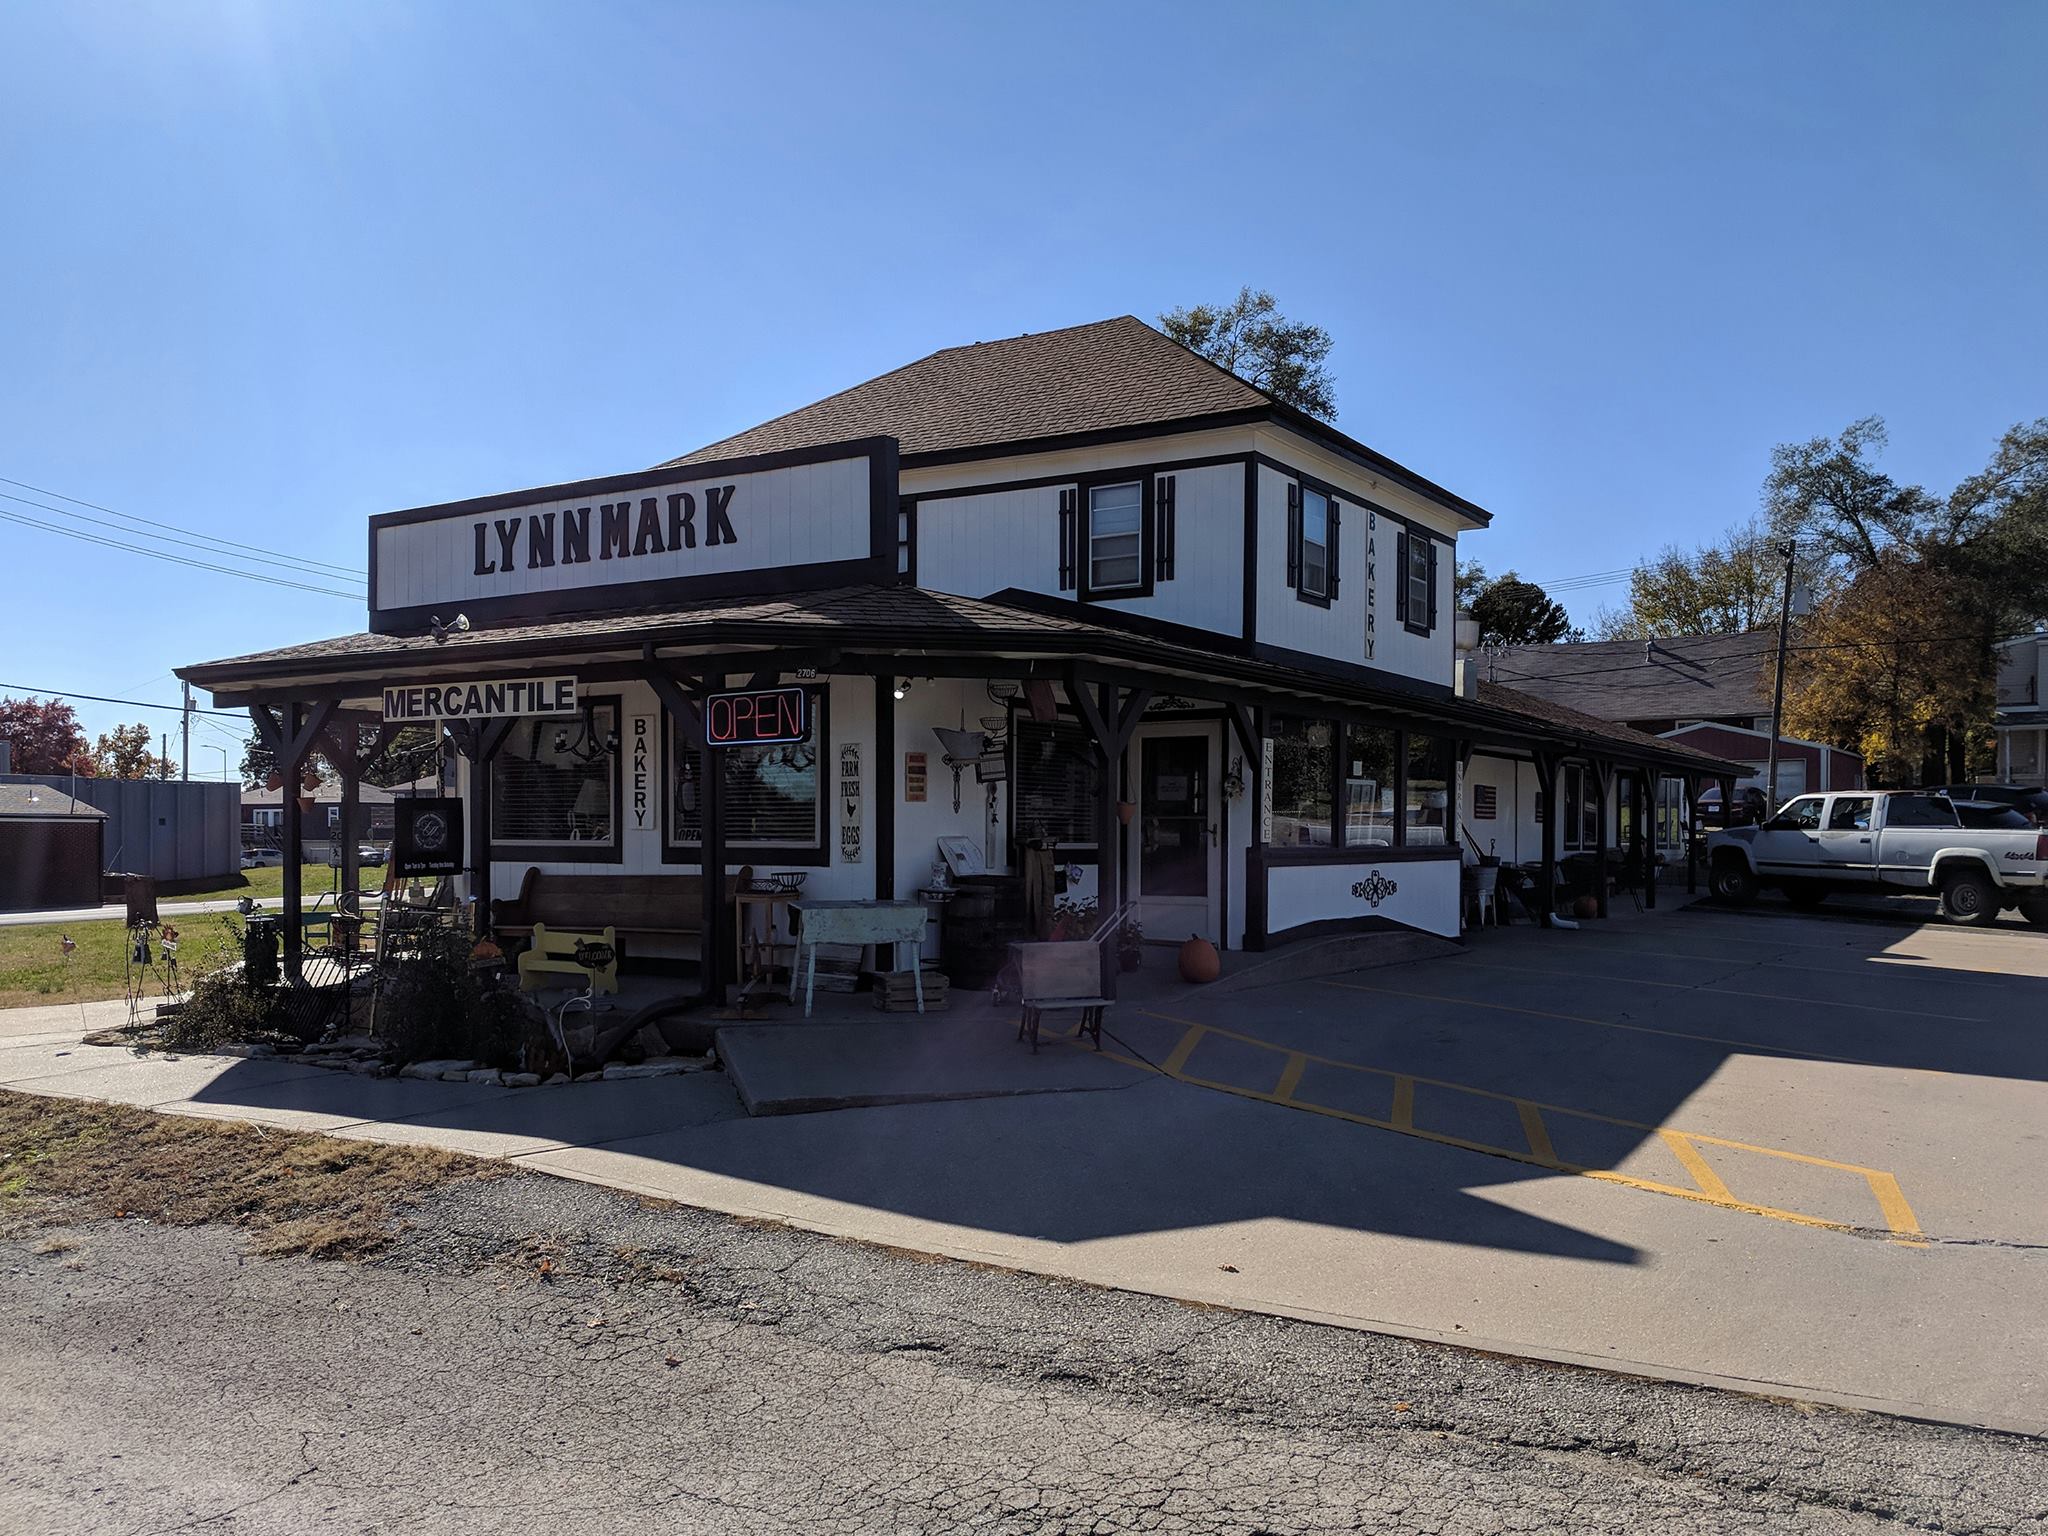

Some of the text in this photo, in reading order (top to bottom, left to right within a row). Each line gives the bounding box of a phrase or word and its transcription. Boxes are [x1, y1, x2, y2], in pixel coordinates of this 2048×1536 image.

[473, 485, 738, 576] LYNNMARK
[1367, 511, 1376, 657] BAKERY
[796, 668, 816, 679] 2706
[384, 679, 575, 719] MERCANTILE
[711, 693, 800, 740] OPEN
[633, 718, 648, 827] BAKERY
[840, 780, 860, 797] FRESH
[841, 760, 859, 777] FARM
[1263, 741, 1273, 840] ENTRANCE
[841, 826, 860, 845] EGGS
